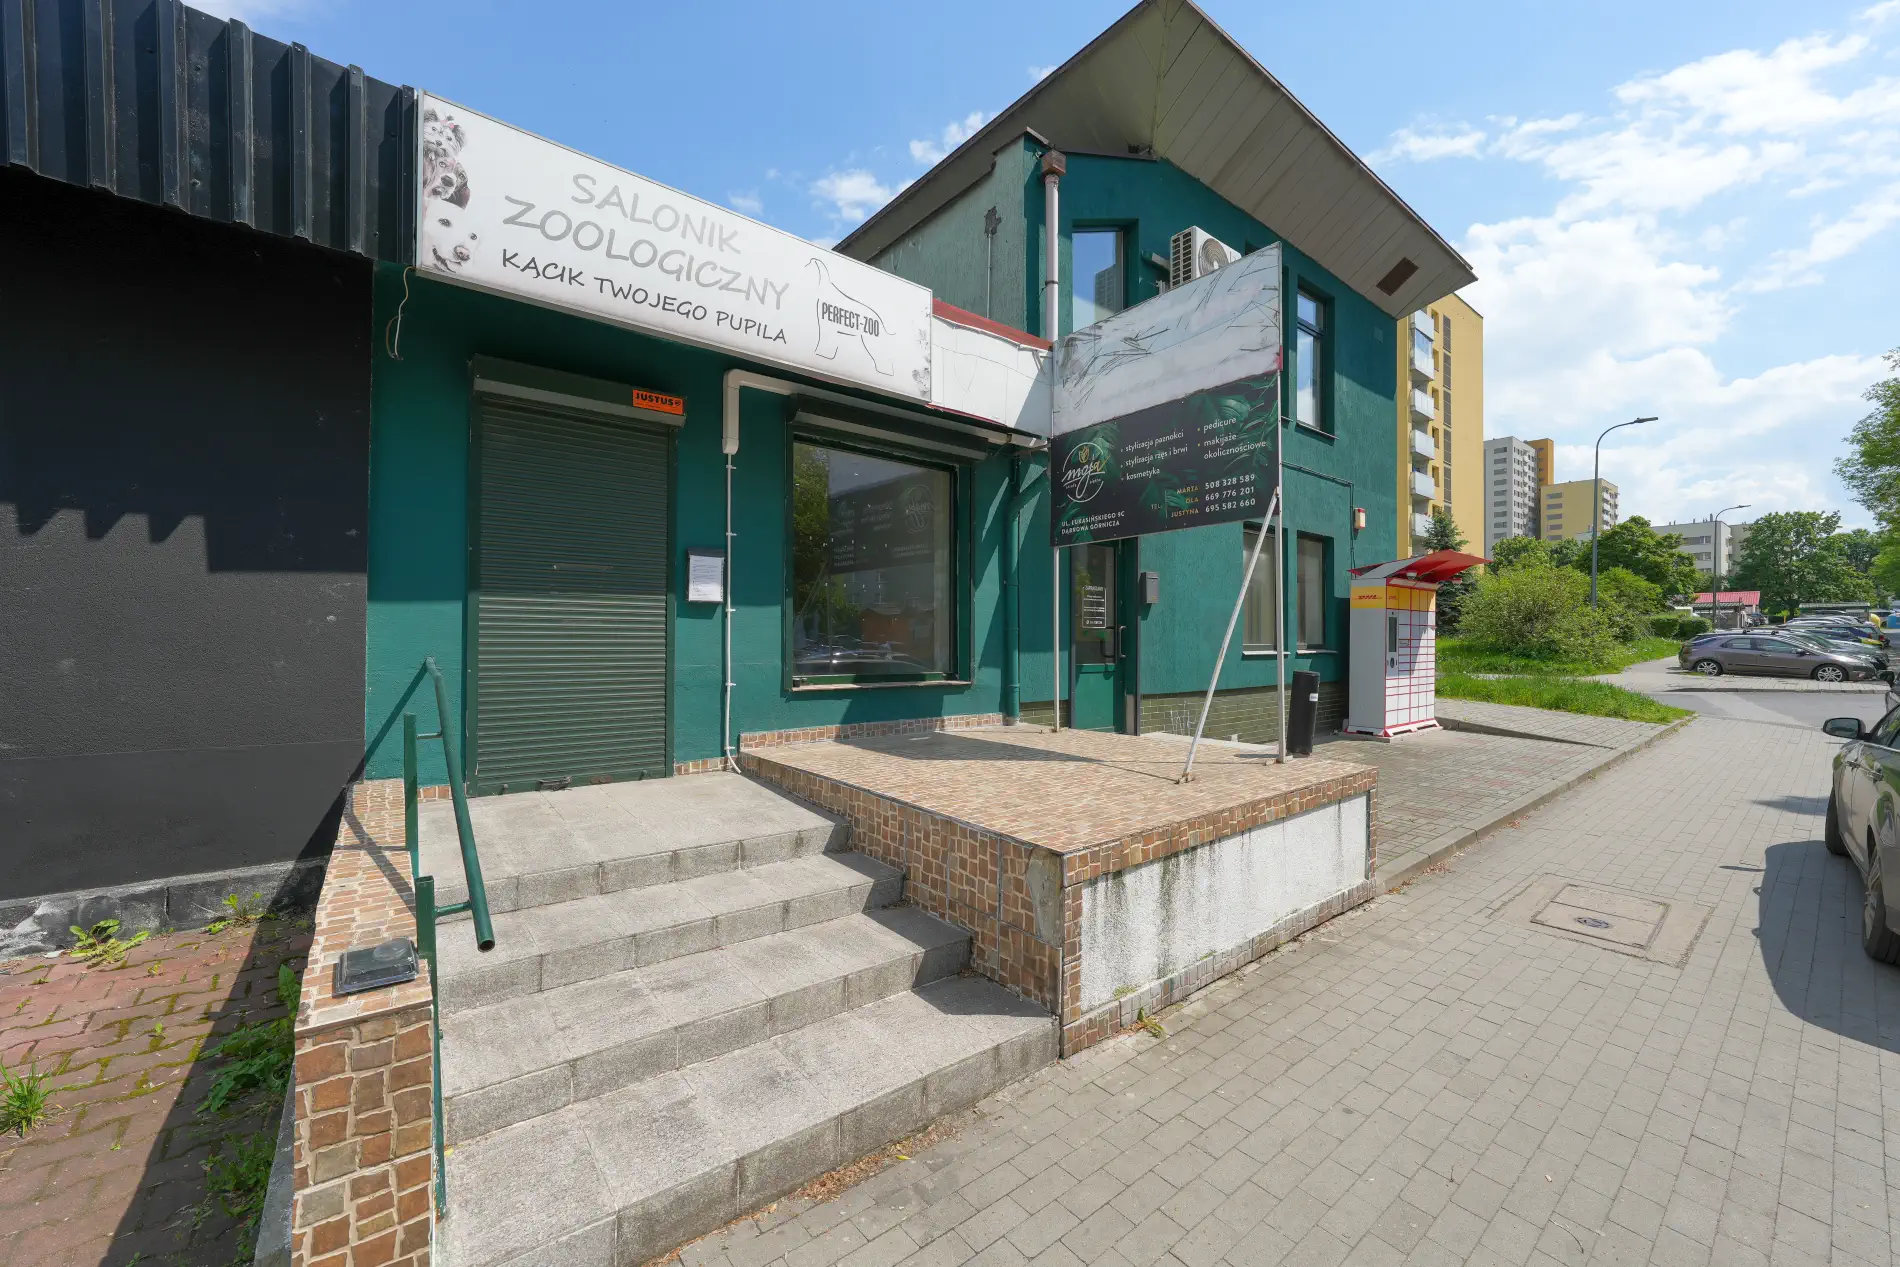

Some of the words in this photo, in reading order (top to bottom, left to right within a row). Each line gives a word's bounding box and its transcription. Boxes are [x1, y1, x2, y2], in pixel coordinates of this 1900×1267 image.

[571, 173, 742, 254] SALONIK
[503, 195, 790, 311] ZOOLOGICZNY
[502, 249, 585, 288] KĄCIK
[593, 276, 707, 321] TWOJEGO
[715, 310, 787, 344] PUPILA
[821, 301, 880, 337] PERFECT-ZOO
[635, 391, 674, 406] JUSTUS
[1203, 417, 1237, 434] pedicure
[1125, 438, 1154, 452] stylizacja
[1154, 429, 1184, 448] paznokci
[1203, 432, 1237, 447] makijaże
[1203, 440, 1267, 460] okolicznościowe
[1125, 453, 1154, 468] stylizacja
[1154, 451, 1168, 460] rzęs
[1173, 443, 1188, 455] brwi
[1126, 466, 1160, 480] kosmetyka
[1176, 485, 1199, 495] MARTA
[1205, 480, 1220, 490] 508
[1222, 477, 1237, 487] 328
[1240, 473, 1255, 484] 589
[1205, 492, 1220, 501] 669
[1222, 489, 1237, 499] 776
[1240, 486, 1254, 496] 201
[1171, 508, 1200, 518] JUSTYNA
[1205, 504, 1220, 513] 695
[1222, 501, 1237, 510] 582
[1240, 498, 1256, 507] 660
